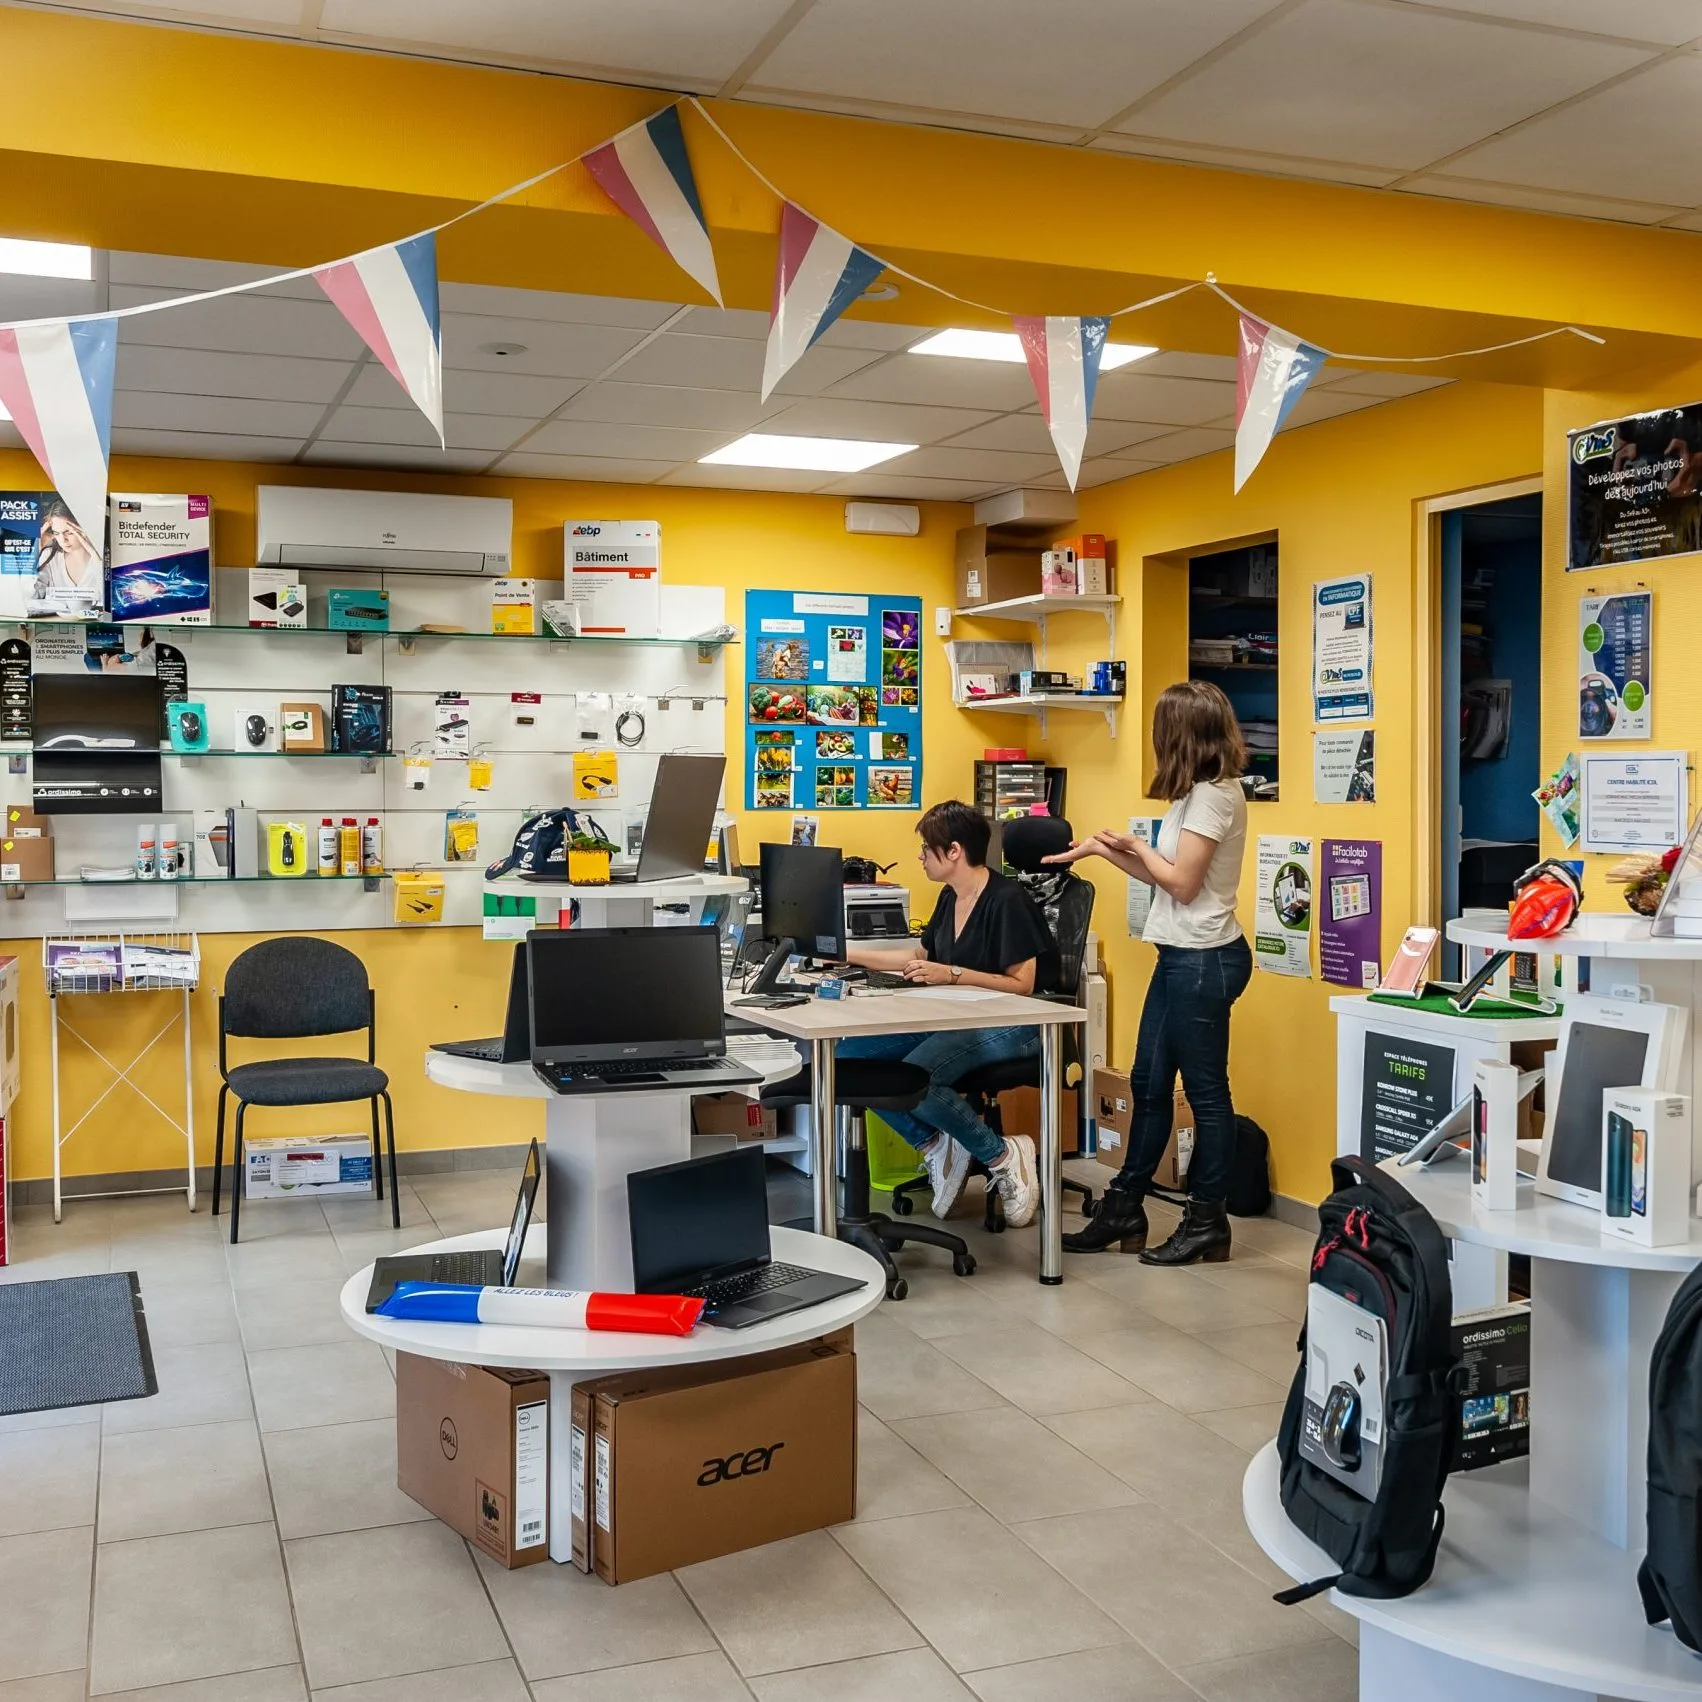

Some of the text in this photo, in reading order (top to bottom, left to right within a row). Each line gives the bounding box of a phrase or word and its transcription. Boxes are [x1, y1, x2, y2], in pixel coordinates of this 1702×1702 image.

[1588, 458, 1684, 486] Développez vos photos
[1605, 478, 1668, 500] dès aujourd'hui
[0, 500, 28, 510] PACK
[1, 511, 38, 520] ASSIST
[119, 521, 176, 531] Bitdefender
[580, 525, 600, 537] ebp
[119, 531, 190, 540] TOTAL SECURITY
[575, 551, 629, 562] Bâtiment
[1349, 605, 1361, 616] CPF
[1338, 844, 1368, 858] Facilotab
[1383, 1051, 1400, 1060] ESPACE
[1388, 1061, 1426, 1080] TARIFS
[493, 1287, 524, 1295] ALLEZ
[543, 1290, 572, 1298] BLEUS
[1355, 1327, 1375, 1342] DICOTA
[1462, 1328, 1506, 1344] ordissimo
[1506, 1323, 1528, 1335] Celia
[442, 1430, 456, 1448] DELL
[697, 1442, 785, 1487] acer
